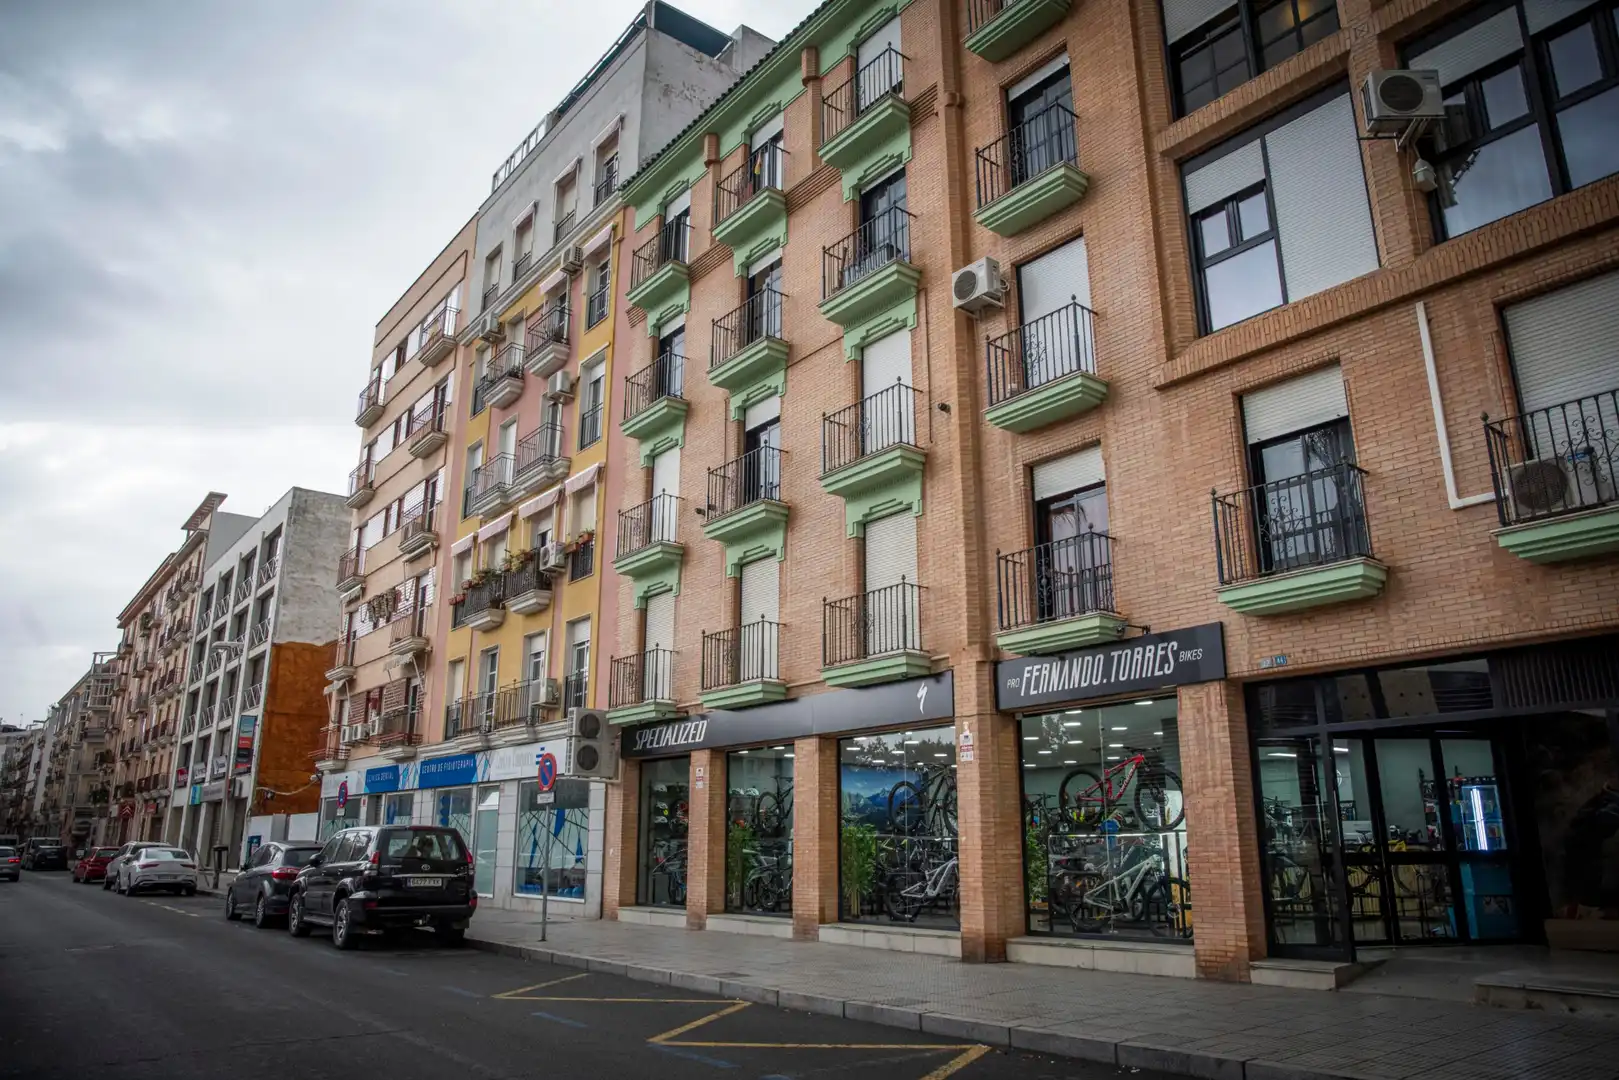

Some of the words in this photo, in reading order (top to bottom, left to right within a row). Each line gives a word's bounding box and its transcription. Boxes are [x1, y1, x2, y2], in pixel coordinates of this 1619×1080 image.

[1006, 677, 1020, 690] PRO
[1020, 641, 1178, 697] FERNANDO.TORRES
[1178, 648, 1203, 663] BIKES
[632, 719, 708, 751] SPECIALIZED
